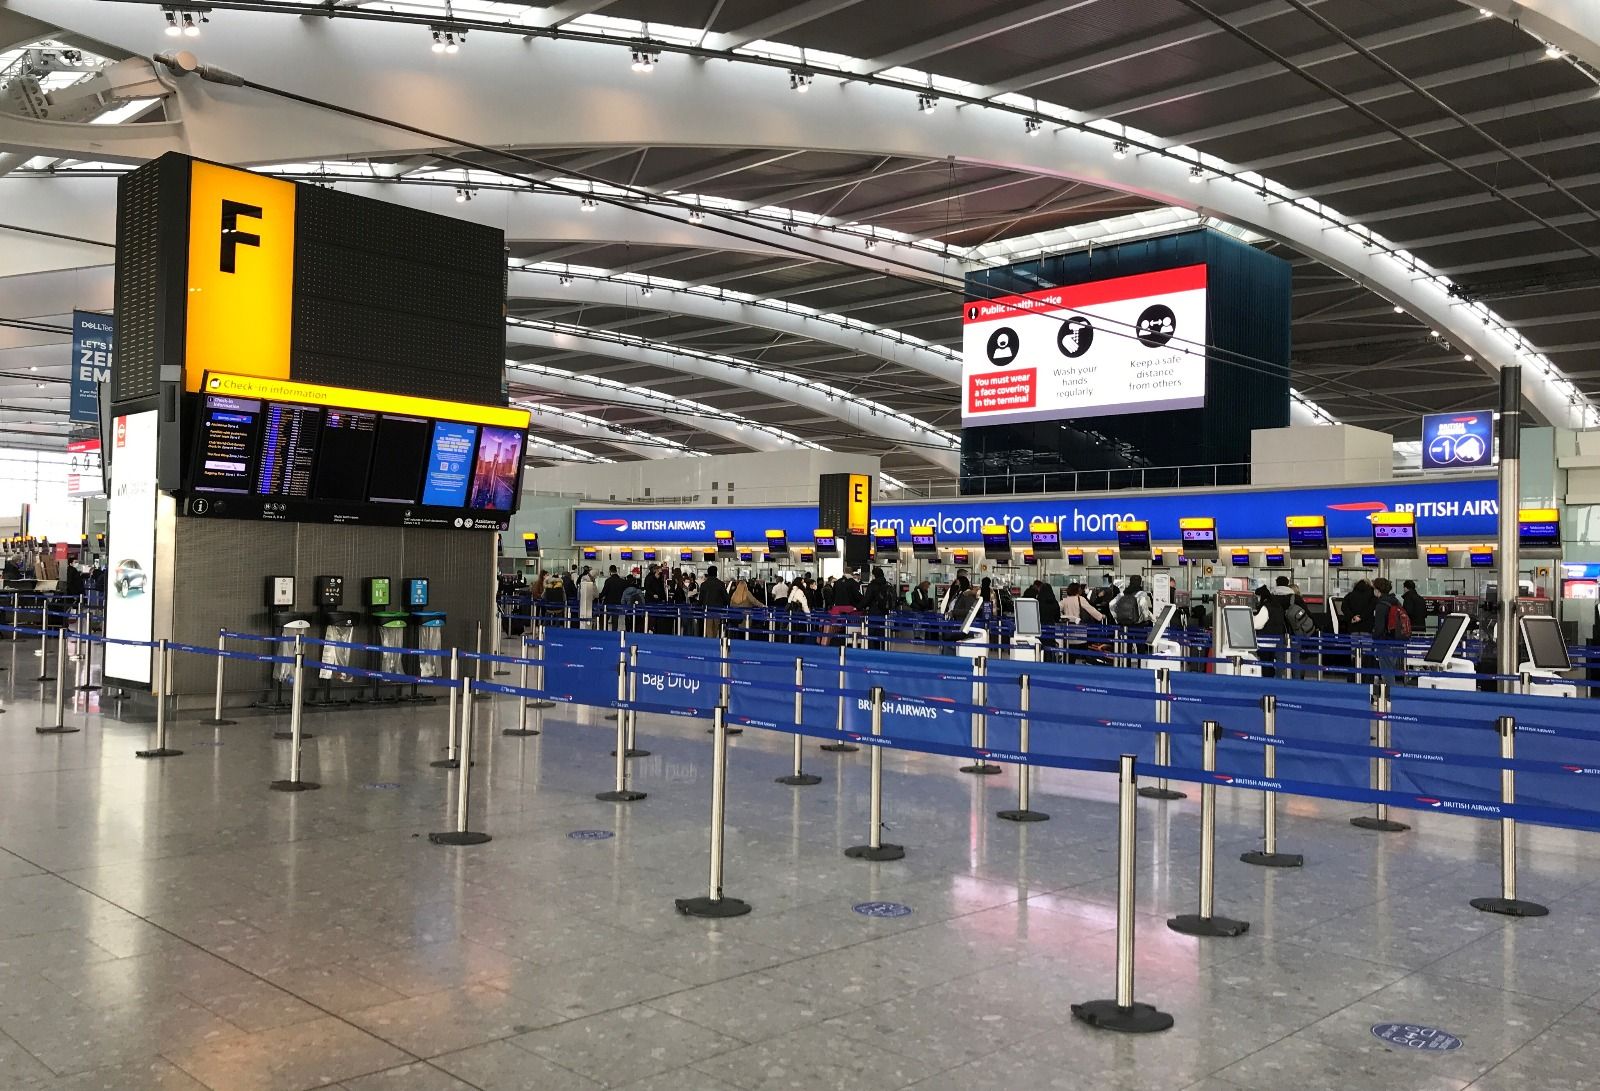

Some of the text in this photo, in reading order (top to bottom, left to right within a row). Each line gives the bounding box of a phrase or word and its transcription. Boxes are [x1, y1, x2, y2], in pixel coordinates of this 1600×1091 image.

[220, 199, 262, 274] F
[981, 304, 1006, 316] Public
[81, 339, 107, 350] LET'S
[1130, 360, 1153, 369] Keep
[1163, 355, 1182, 364] safe
[1053, 366, 1097, 377] Wash your
[1136, 368, 1174, 379] distance
[975, 374, 1031, 386] You must wear
[1062, 377, 1088, 387] hands
[1129, 379, 1183, 391] from others
[223, 379, 328, 400] Check-in information
[980, 387, 997, 397] face
[996, 384, 1030, 395] covering
[1056, 387, 1094, 399] regularly
[975, 394, 1030, 407] in the terminal
[854, 483, 863, 503] E
[1394, 501, 1459, 517] BRITISH
[631, 520, 706, 531] BRITISH AIRWAYS
[909, 511, 997, 534] welcome
[1002, 514, 1024, 533] to
[642, 672, 665, 691] Bag
[857, 698, 894, 714] BRISH
[895, 703, 937, 719] AIRWAYS
[1235, 778, 1282, 789] BRITISH AIRWAYS
[1443, 801, 1501, 813] BRITISH AIRWAYS
